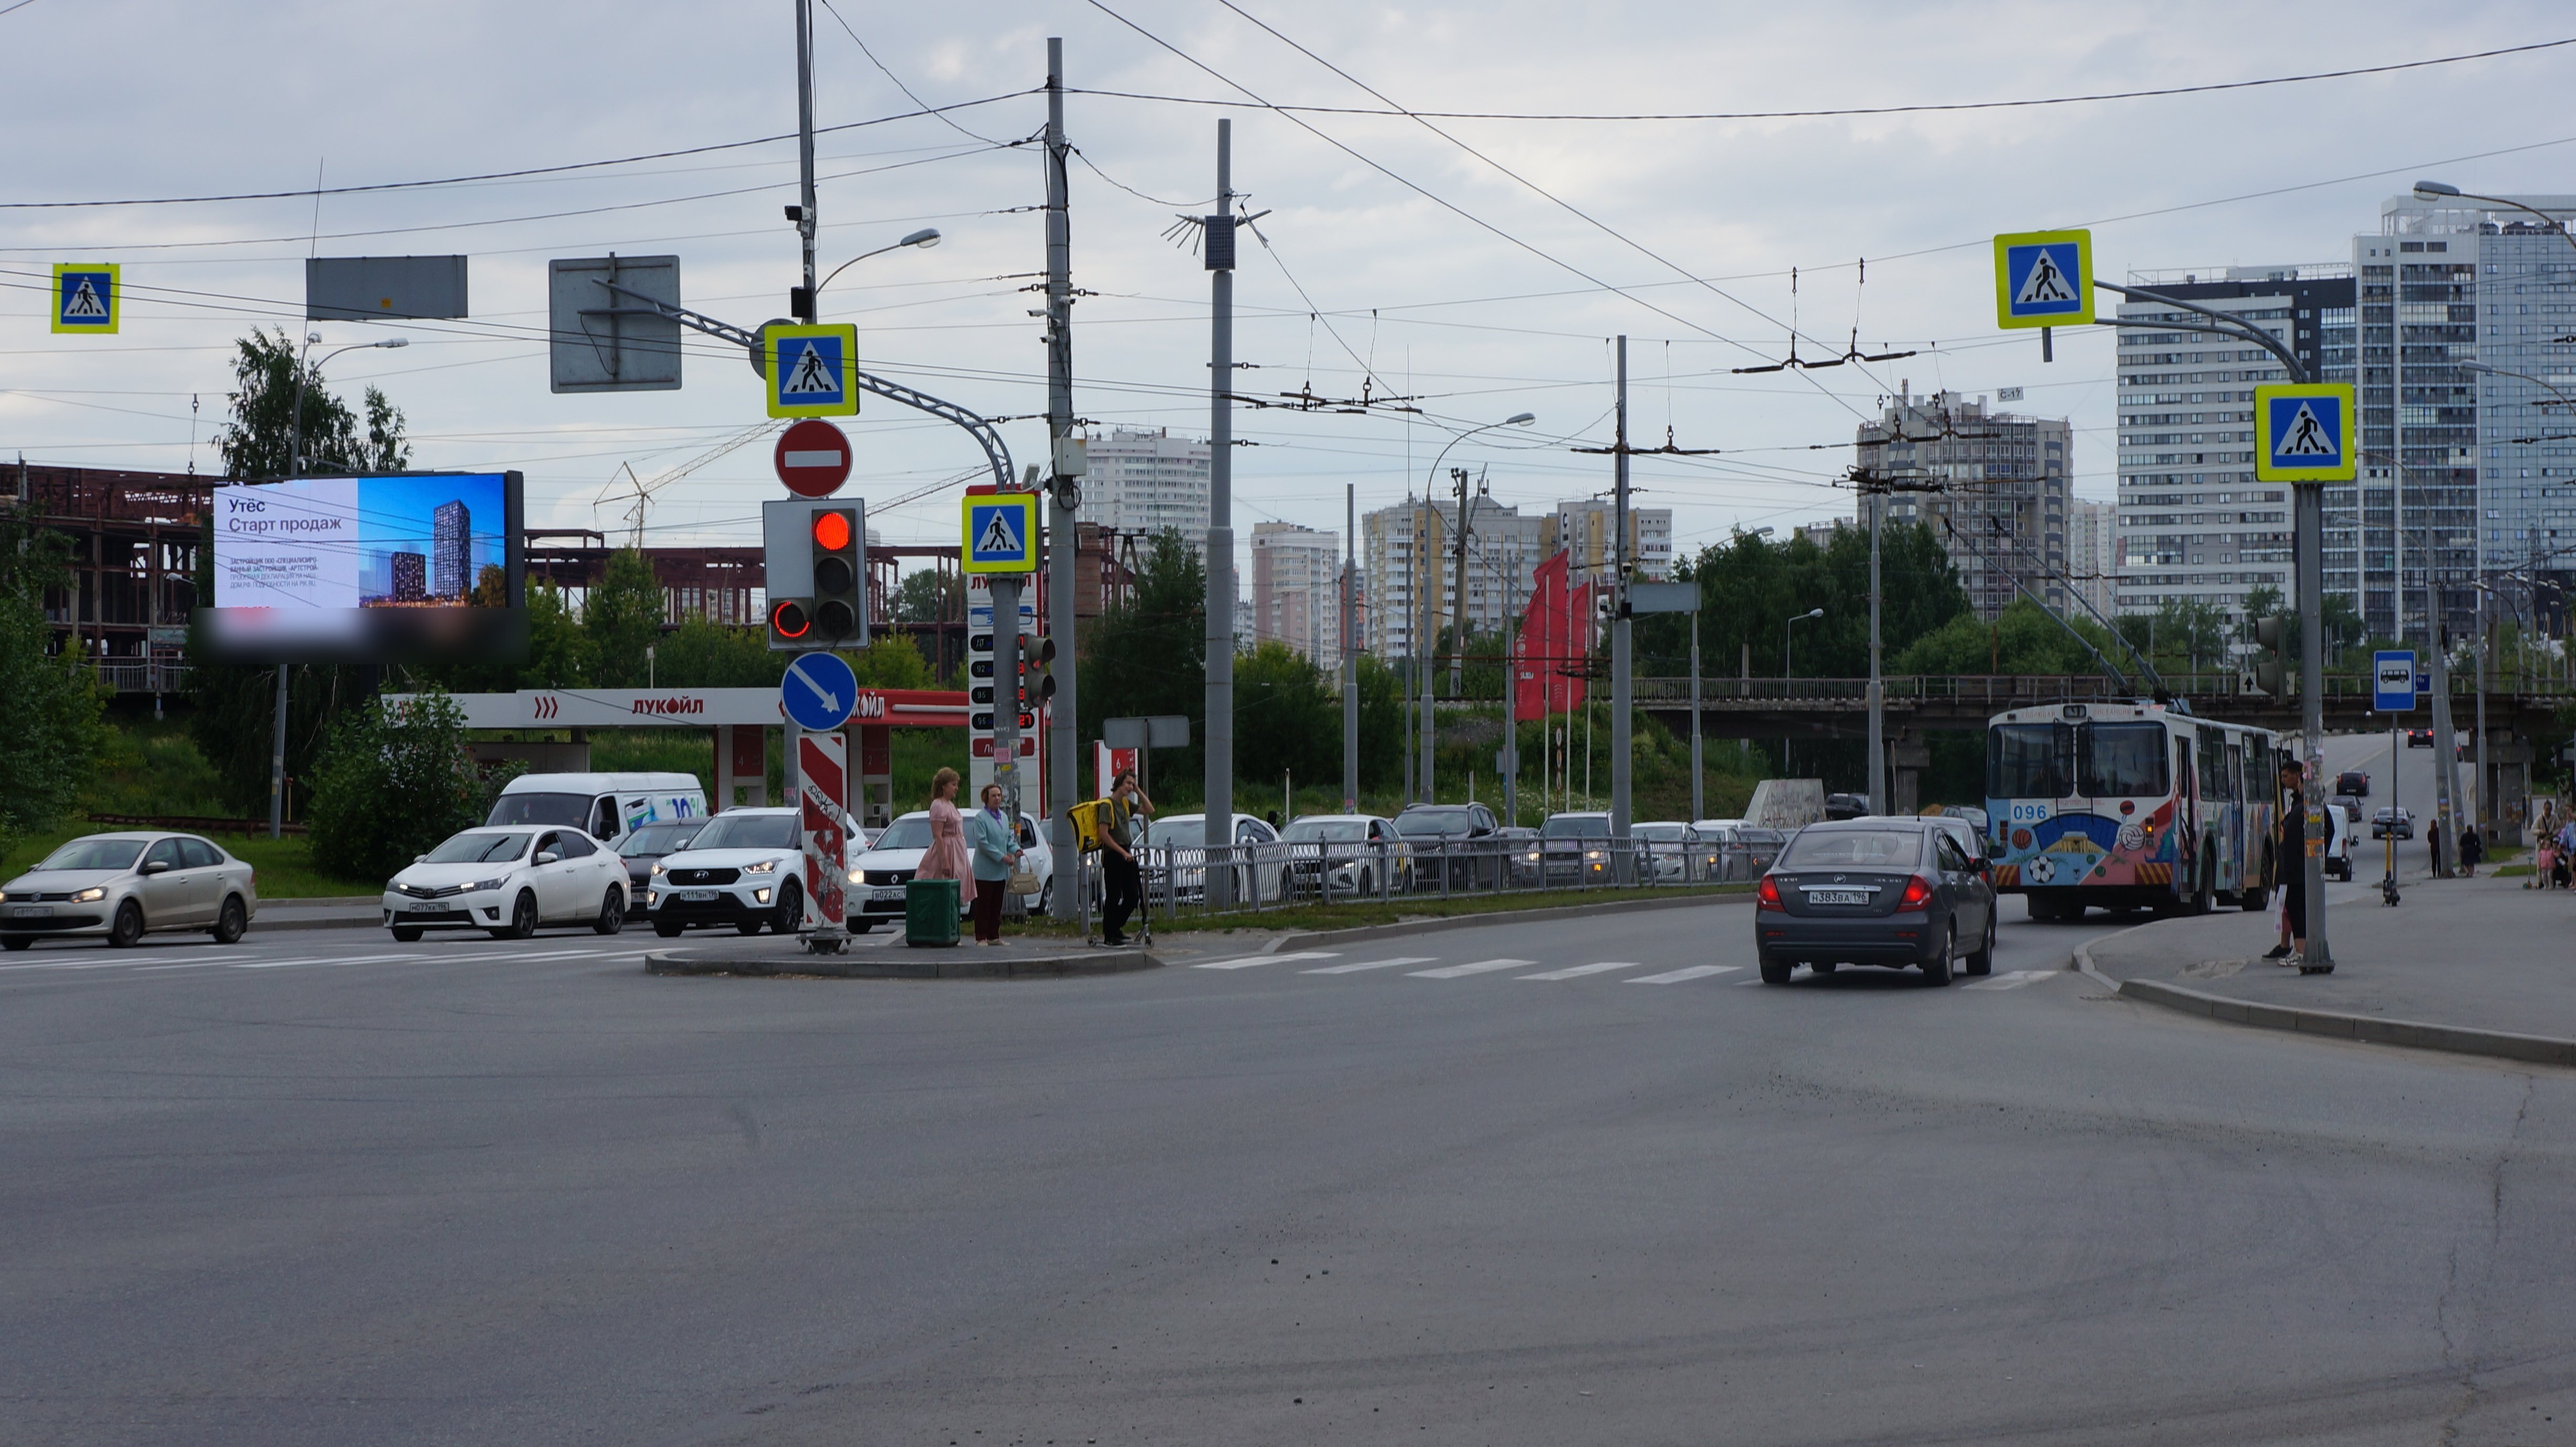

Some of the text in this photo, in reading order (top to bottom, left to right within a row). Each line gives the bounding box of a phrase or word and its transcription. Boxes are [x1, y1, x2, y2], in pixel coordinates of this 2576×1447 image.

[229, 498, 265, 513] Утёс
[229, 518, 342, 534] Старт продаж
[632, 696, 703, 714] ЛУКОЙЛ
[1116, 758, 1121, 770] 6
[2013, 805, 2047, 820] 096
[1811, 892, 1866, 902] Н383ВА 196
